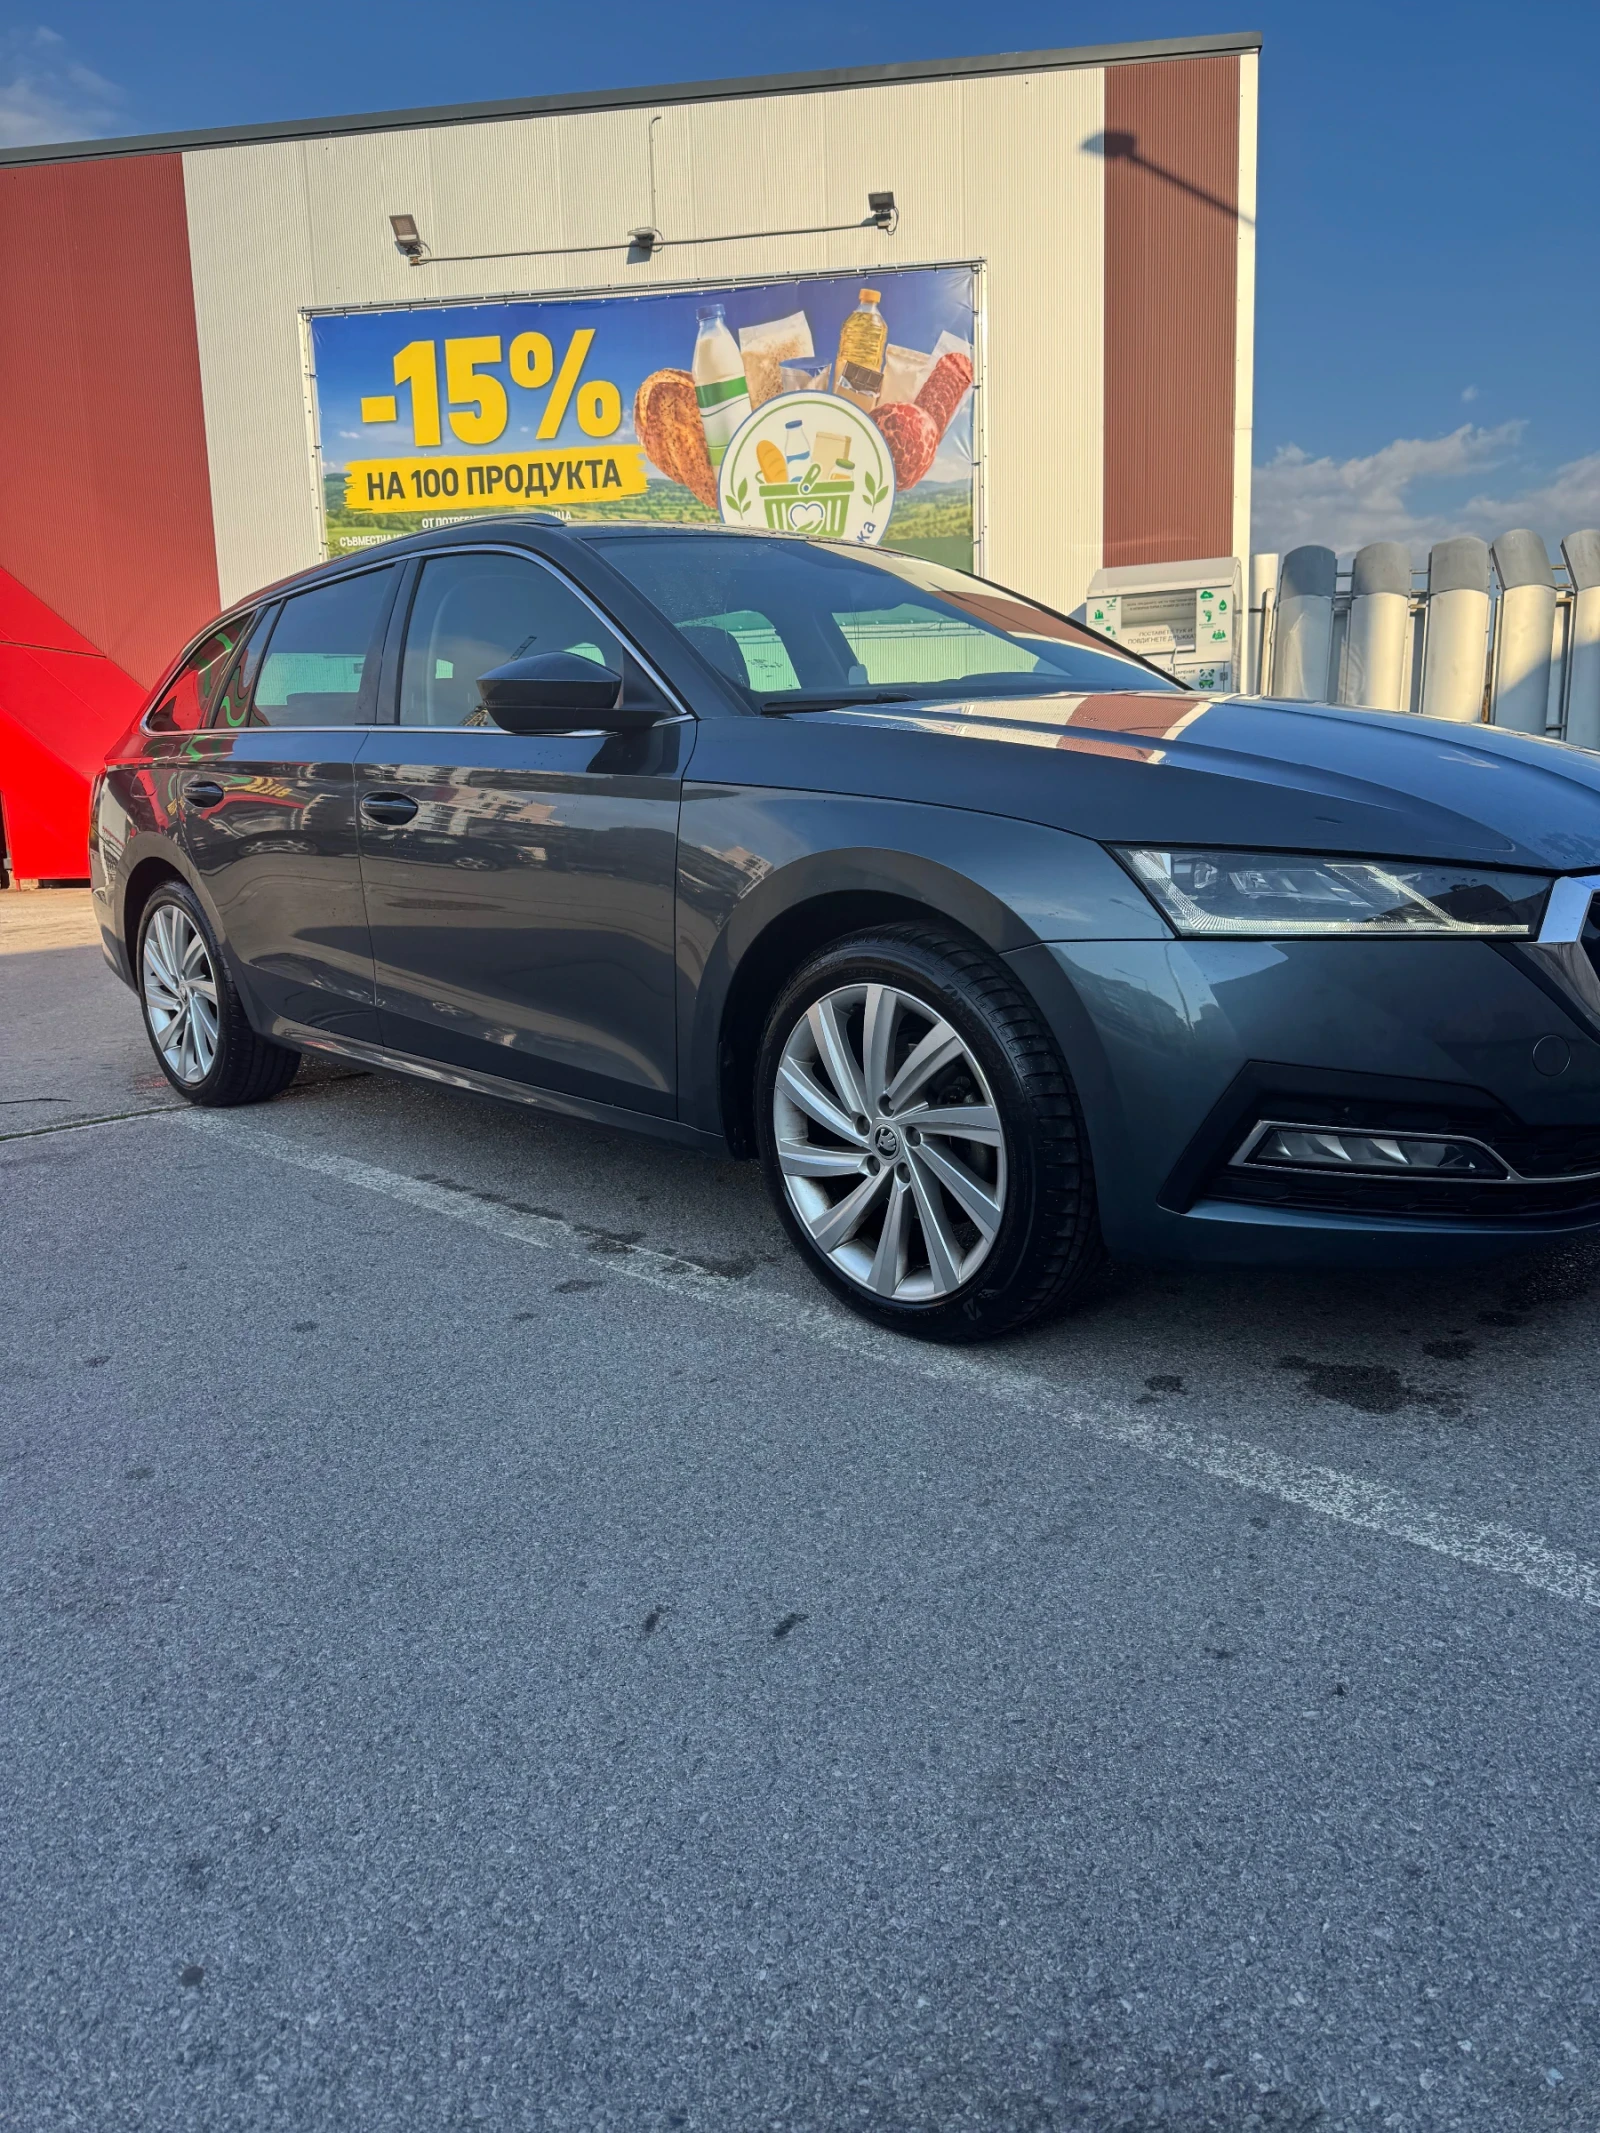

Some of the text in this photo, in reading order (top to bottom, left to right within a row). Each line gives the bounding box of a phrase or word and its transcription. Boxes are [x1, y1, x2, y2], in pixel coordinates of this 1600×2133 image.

[360, 328, 622, 447] -15%
[367, 459, 622, 501] НА 100 ПРОДУКТА
[421, 517, 434, 529] ОТ
[339, 534, 392, 548] СЪВМЕСТНА
